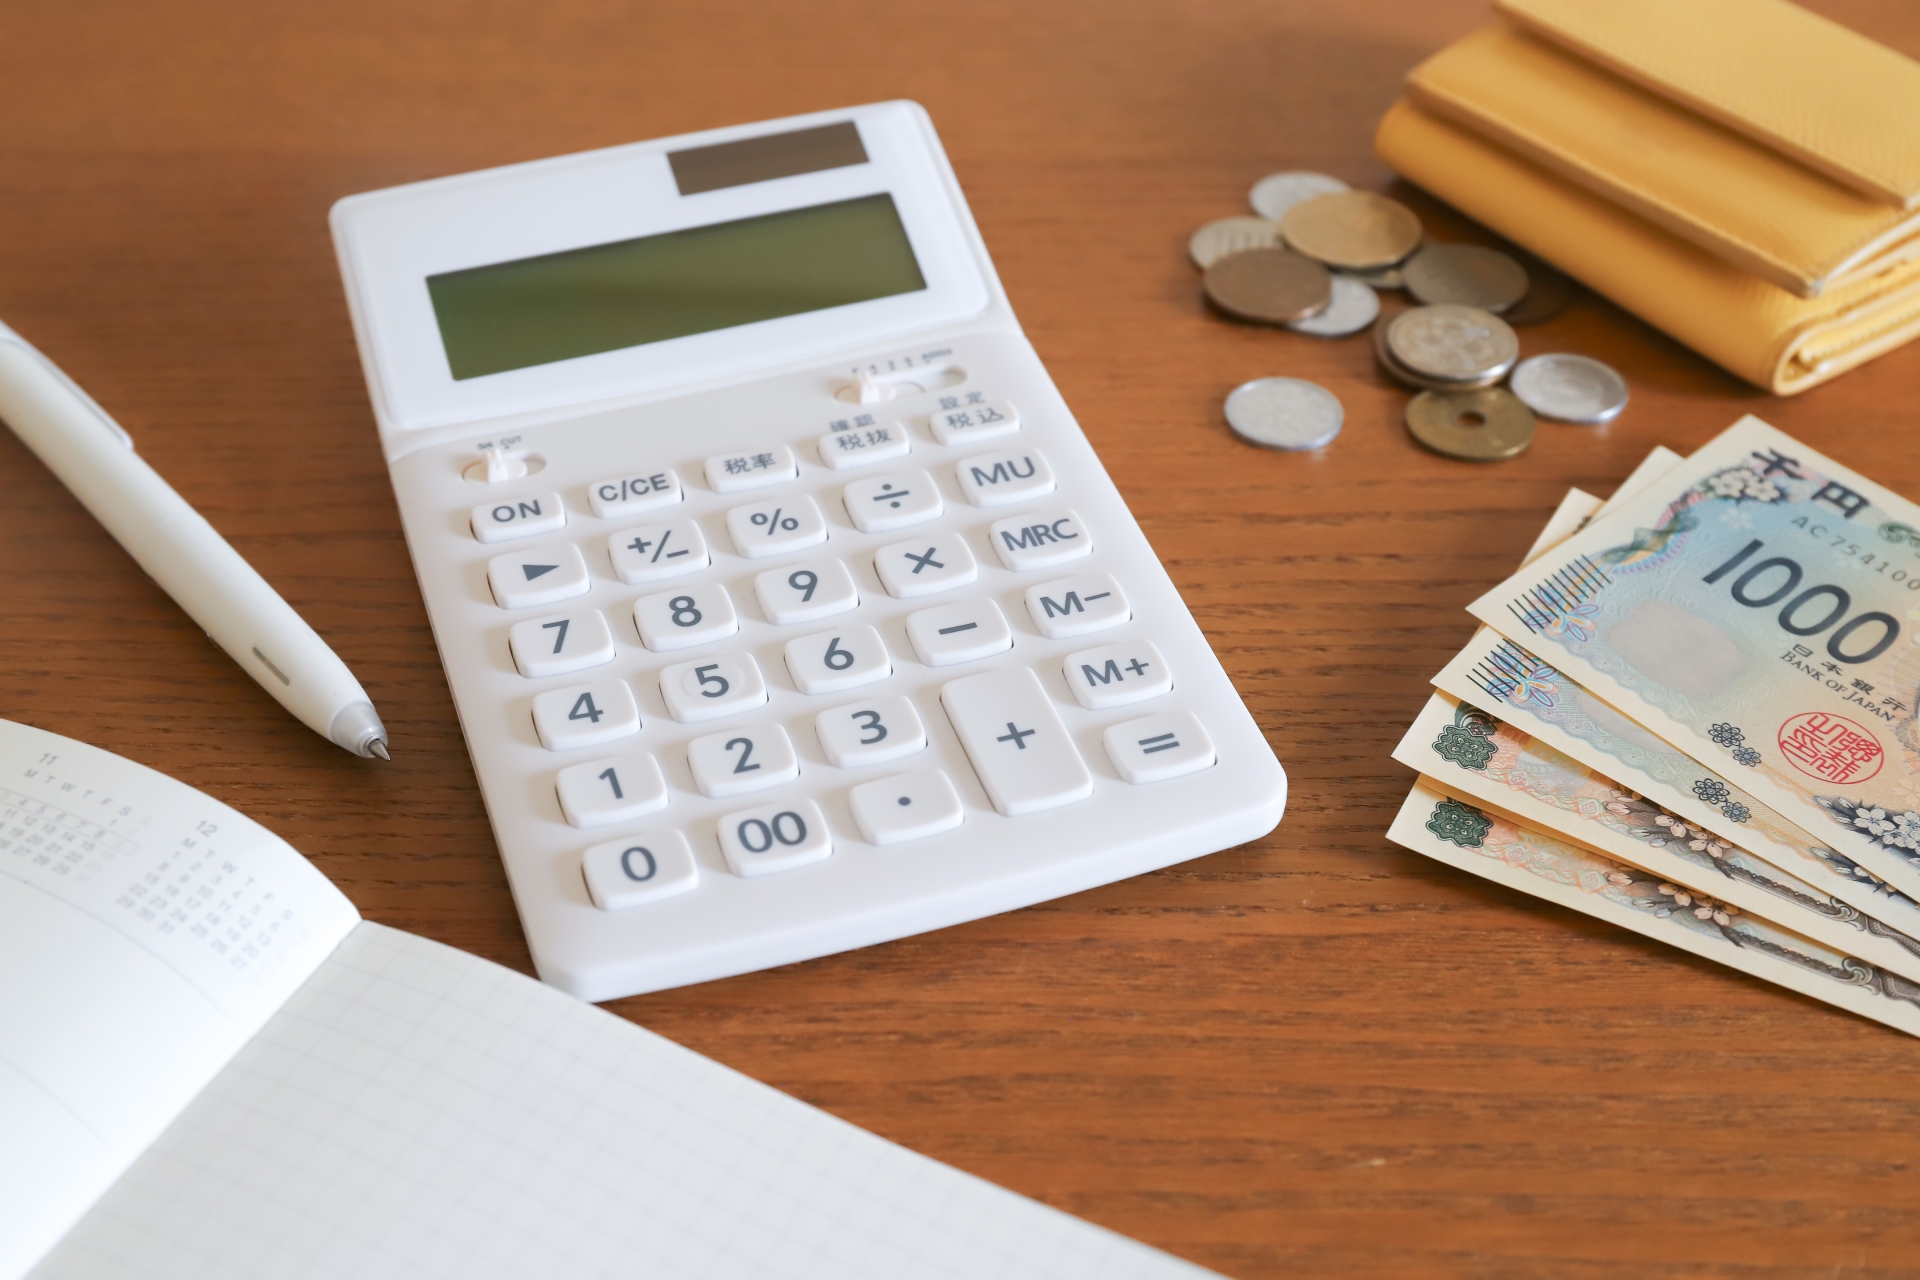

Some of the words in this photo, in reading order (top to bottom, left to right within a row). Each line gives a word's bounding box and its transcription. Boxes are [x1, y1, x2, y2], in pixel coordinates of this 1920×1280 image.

[945, 407, 1004, 430] 税込
[500, 434, 522, 446] CUT
[836, 429, 893, 451] 税抜
[724, 452, 776, 475] 税率
[970, 456, 1036, 487] MU
[598, 473, 670, 502] C/CE
[491, 499, 542, 523] ON
[750, 507, 800, 536] %
[1000, 518, 1078, 552] MRC
[788, 570, 819, 603] 9
[1702, 539, 1899, 665] 1000
[668, 595, 703, 628] 8
[541, 619, 570, 655] 7
[823, 636, 855, 671] 6
[694, 663, 730, 698] 5
[1080, 658, 1150, 687] M+
[1780, 650, 1825, 681] BANK
[1826, 678, 1848, 693] OF
[1842, 690, 1896, 722] JAPAN
[1792, 643, 1910, 713] 日本銀行
[567, 691, 604, 724] 4
[851, 709, 888, 745] 3
[39, 752, 58, 766] 11
[724, 737, 761, 775] 2
[598, 767, 624, 800] 1
[195, 820, 218, 837] 12
[737, 811, 808, 854] 00
[620, 846, 658, 883] 0
